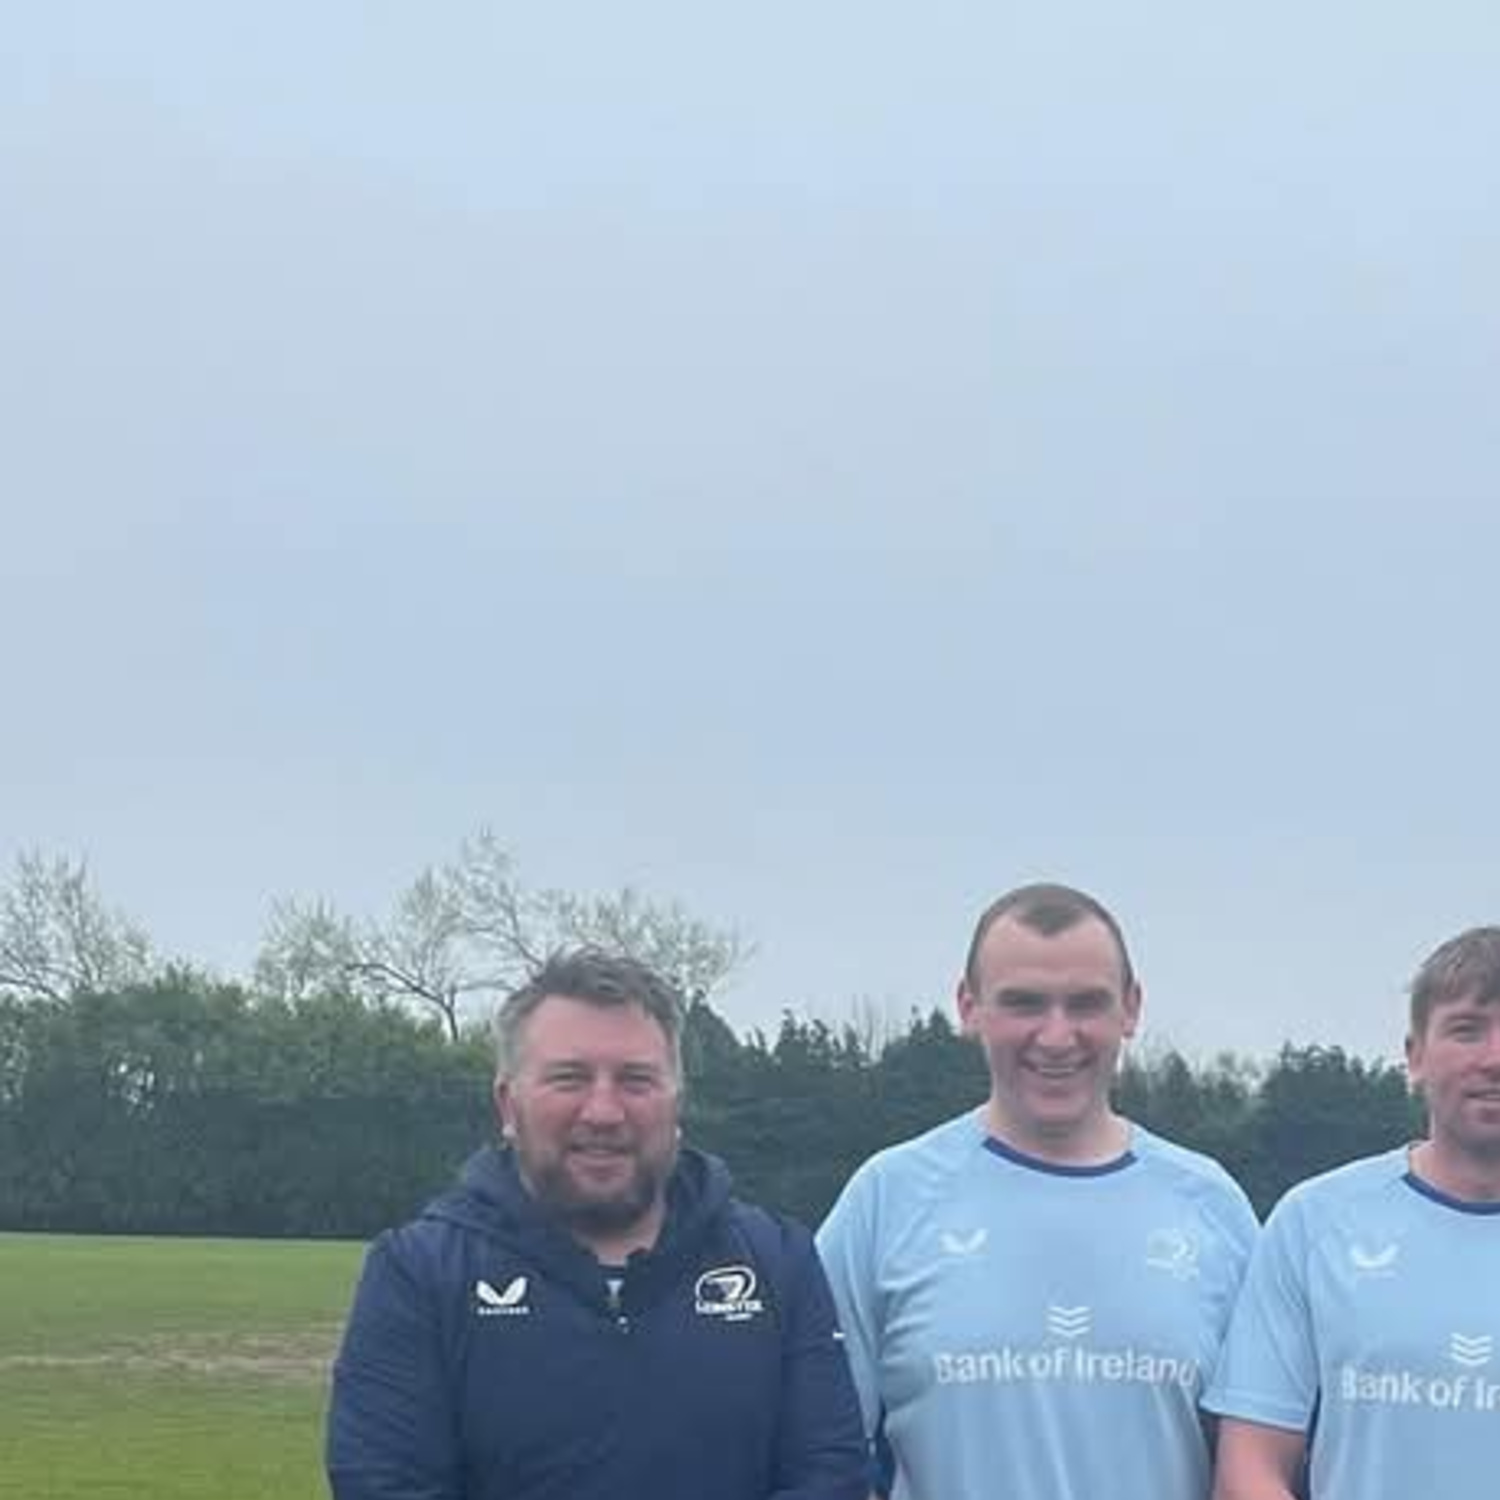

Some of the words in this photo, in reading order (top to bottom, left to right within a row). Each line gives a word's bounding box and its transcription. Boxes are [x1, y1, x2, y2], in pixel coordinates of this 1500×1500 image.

[934, 1347, 1026, 1384] Bank
[1029, 1348, 1070, 1380] of
[1075, 1347, 1200, 1388] Ireland
[1341, 1363, 1421, 1404] Bank
[1428, 1374, 1469, 1409] of
